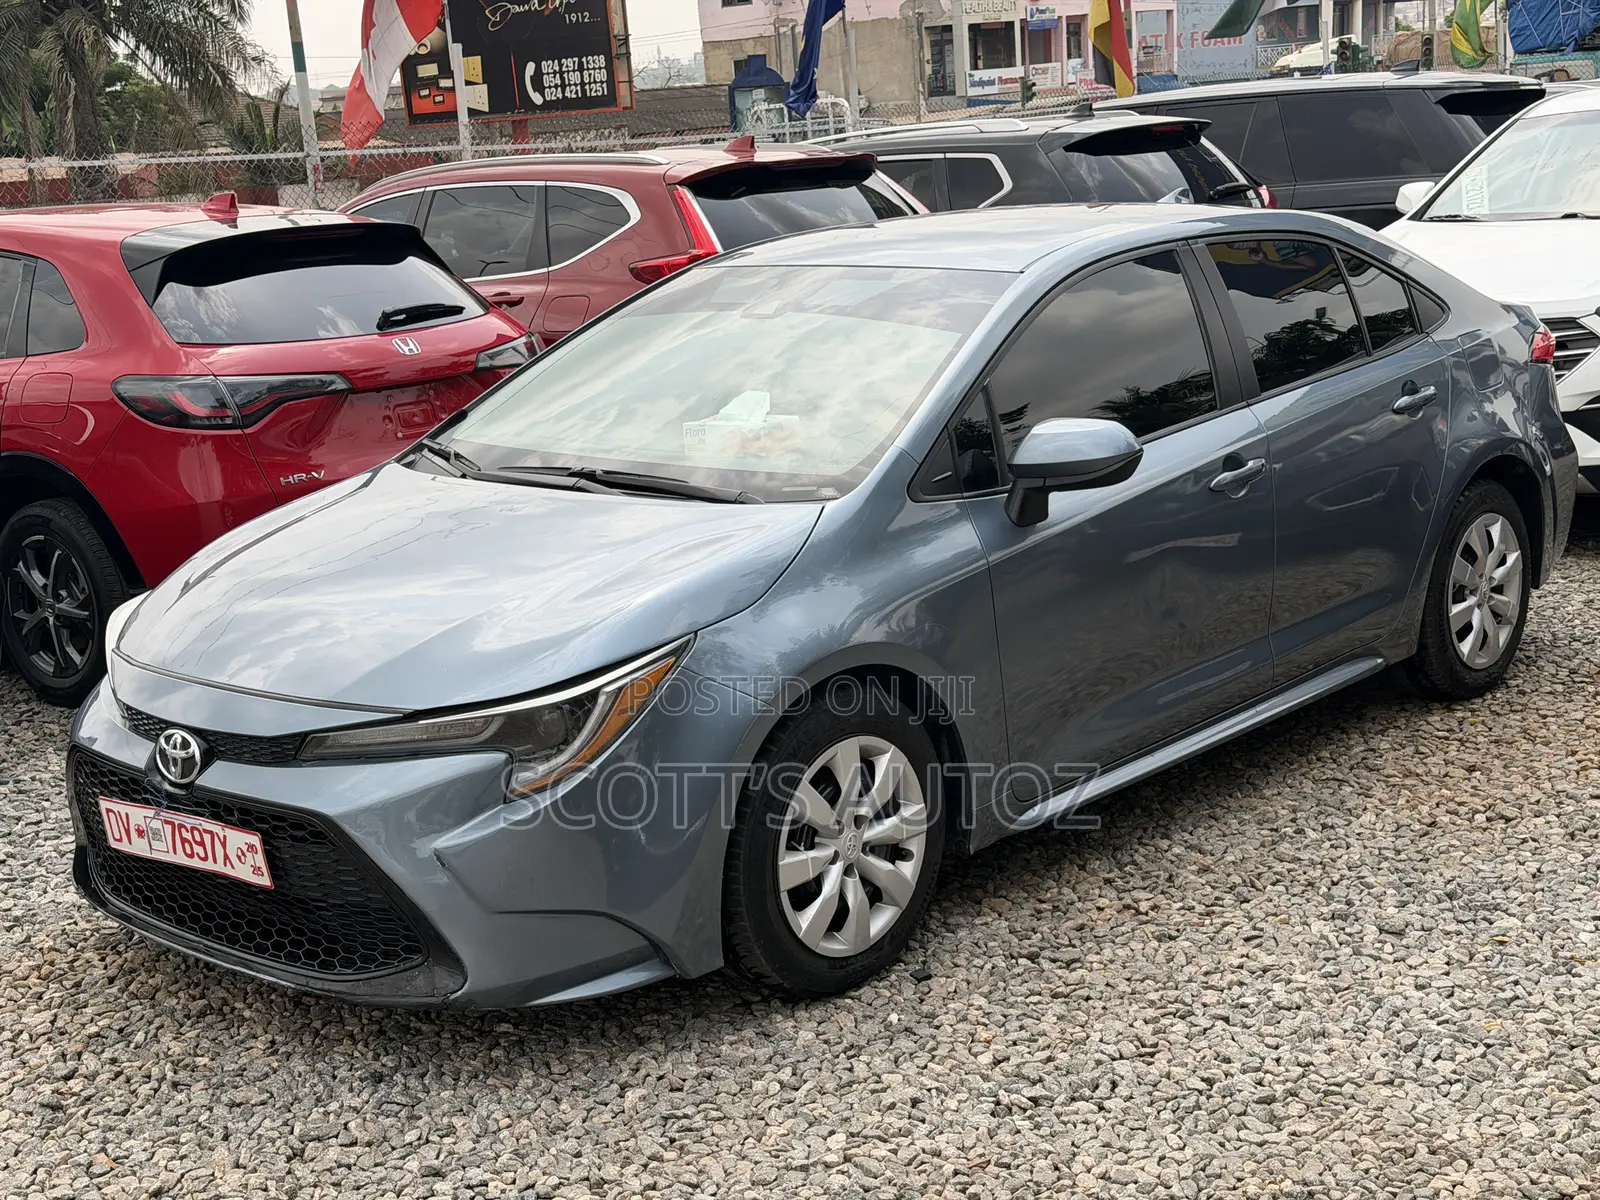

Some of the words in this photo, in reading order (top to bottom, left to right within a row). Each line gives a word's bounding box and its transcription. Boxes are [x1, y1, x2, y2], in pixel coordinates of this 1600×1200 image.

[564, 11, 601, 24] 1912...
[541, 59, 559, 73] 024
[561, 57, 579, 71] 297
[581, 55, 606, 69] 1338
[543, 73, 561, 87] 054
[563, 71, 581, 85] 190
[583, 69, 607, 83] 8760
[544, 87, 563, 101] 024
[565, 85, 581, 98] 421
[584, 82, 608, 97] 1251
[280, 470, 325, 486] HR-V
[105, 807, 132, 846] DV
[163, 818, 236, 870] 7697X
